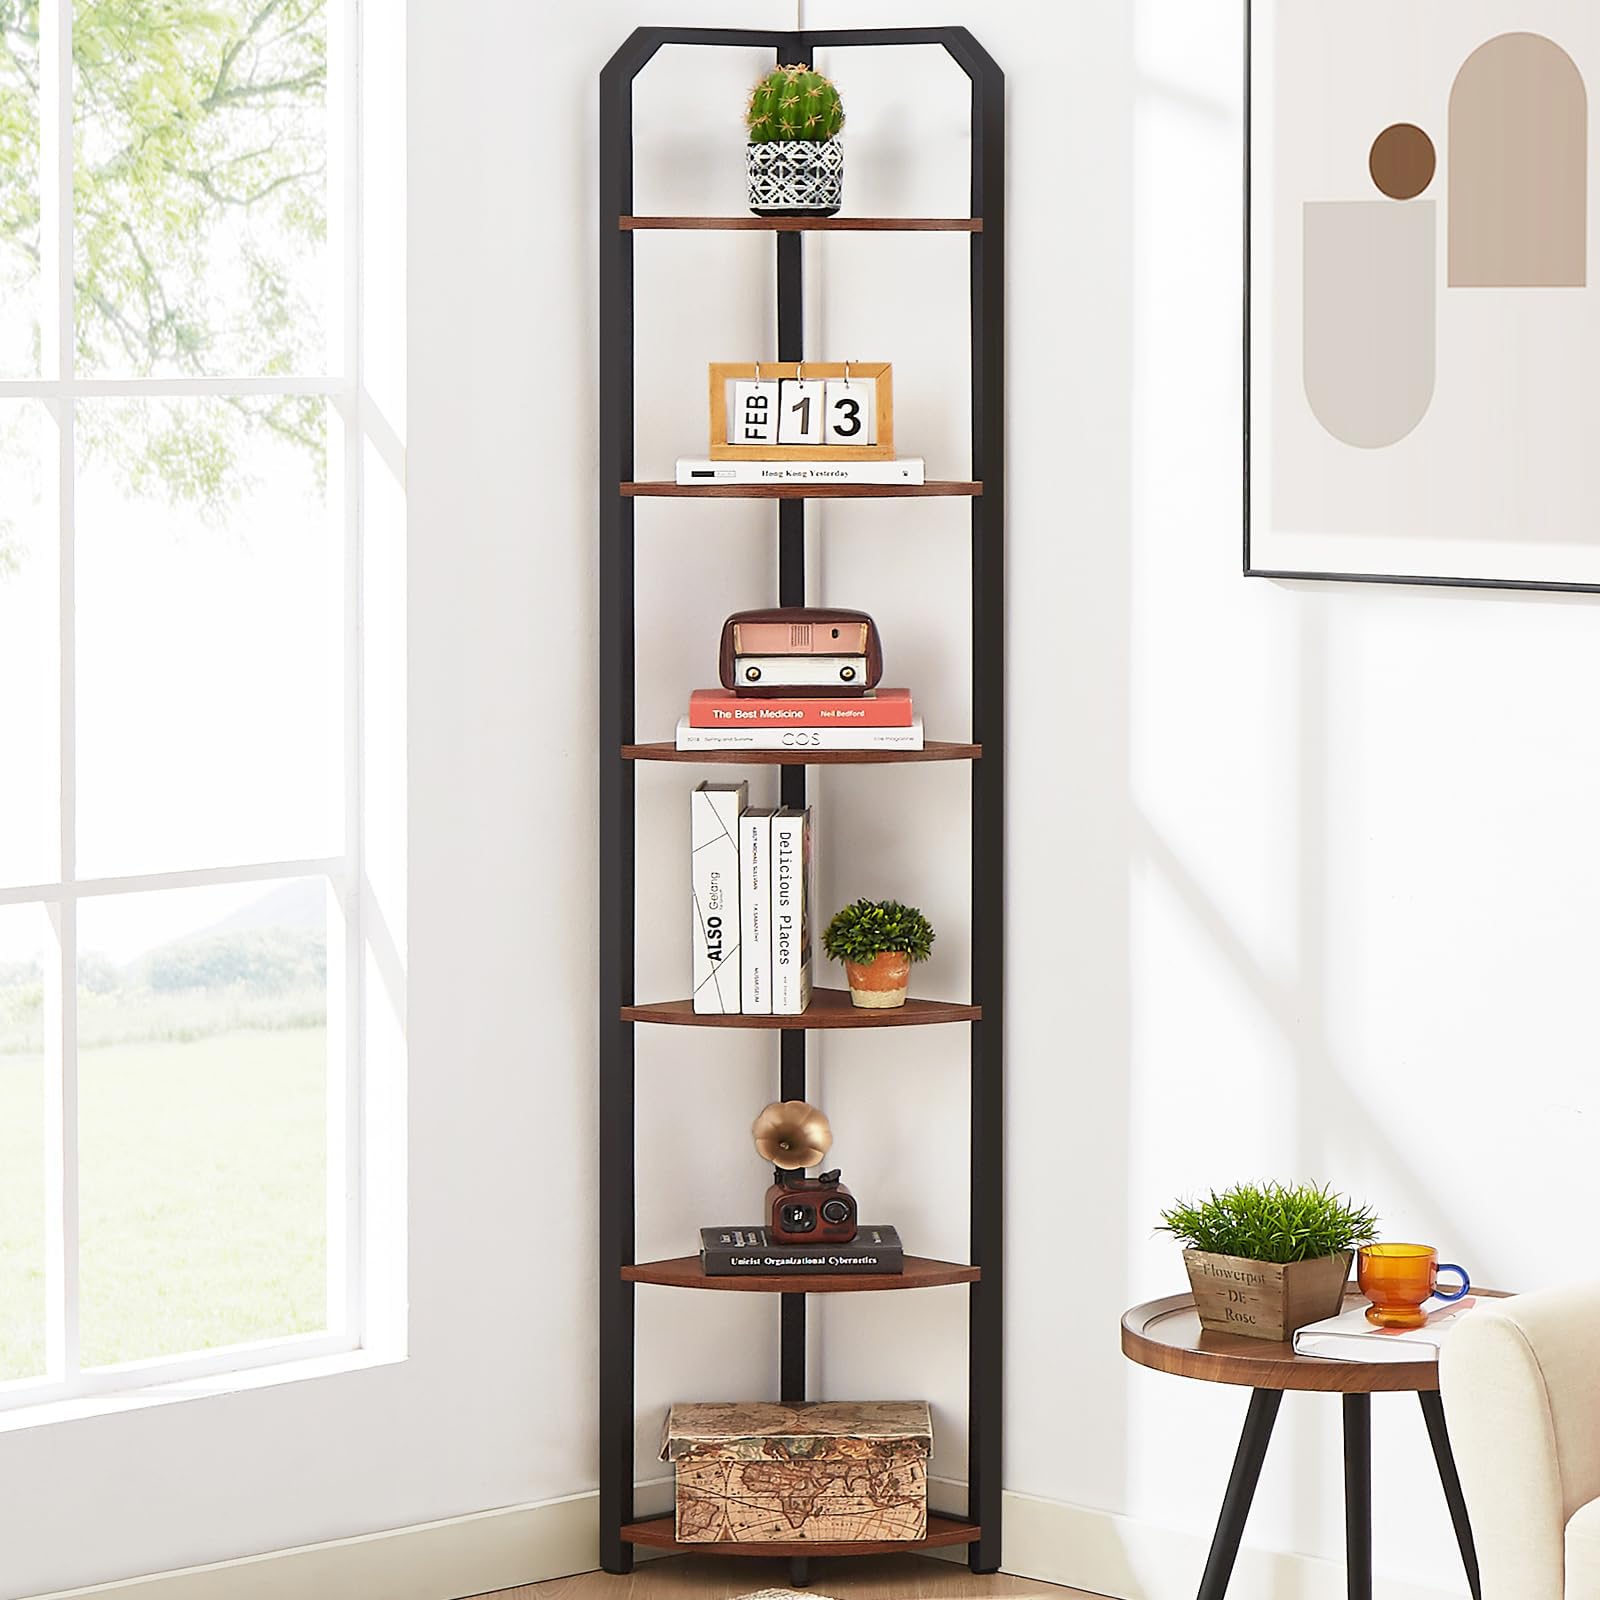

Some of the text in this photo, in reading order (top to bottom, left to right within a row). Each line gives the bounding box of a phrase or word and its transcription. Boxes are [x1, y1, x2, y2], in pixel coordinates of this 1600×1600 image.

[745, 396, 768, 439] FEB
[761, 470, 849, 478] Hong Kong Yesterday
[712, 709, 804, 719] The Best Medicine
[820, 710, 865, 718] Neil Bedford
[782, 732, 821, 746] COS
[780, 833, 792, 906] Delicious
[708, 872, 720, 910] Gelang
[707, 916, 723, 962] ALSO
[780, 916, 792, 964] Places
[731, 1256, 877, 1267] Unicist Organizational Cybernetics
[1203, 1264, 1265, 1286] Flowerpot
[1225, 1307, 1256, 1325] Rose
